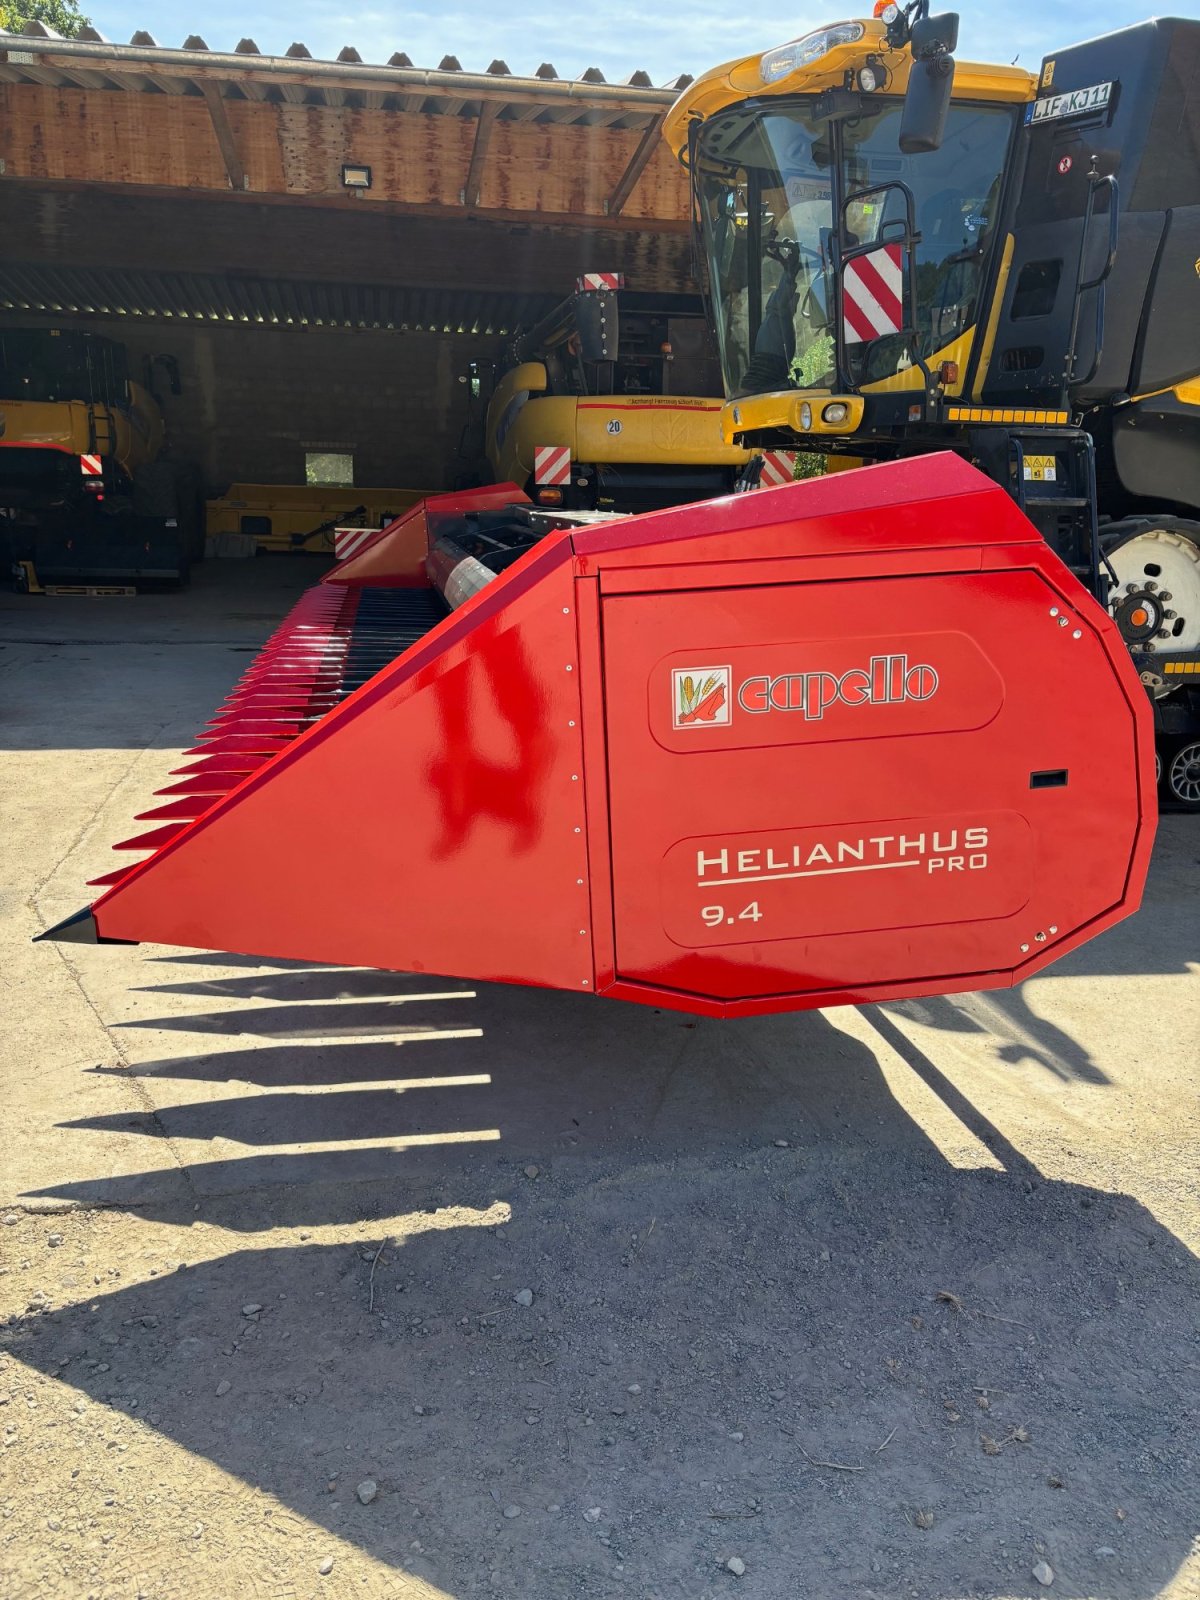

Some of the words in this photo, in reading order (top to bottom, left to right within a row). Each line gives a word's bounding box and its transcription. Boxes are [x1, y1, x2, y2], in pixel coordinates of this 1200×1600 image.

[1033, 97, 1061, 119] LIF
[609, 421, 620, 432] 20
[738, 654, 938, 720] capello
[697, 827, 988, 876] HELIANTHUS
[927, 853, 988, 874] PRO
[701, 901, 763, 927] 9.4
